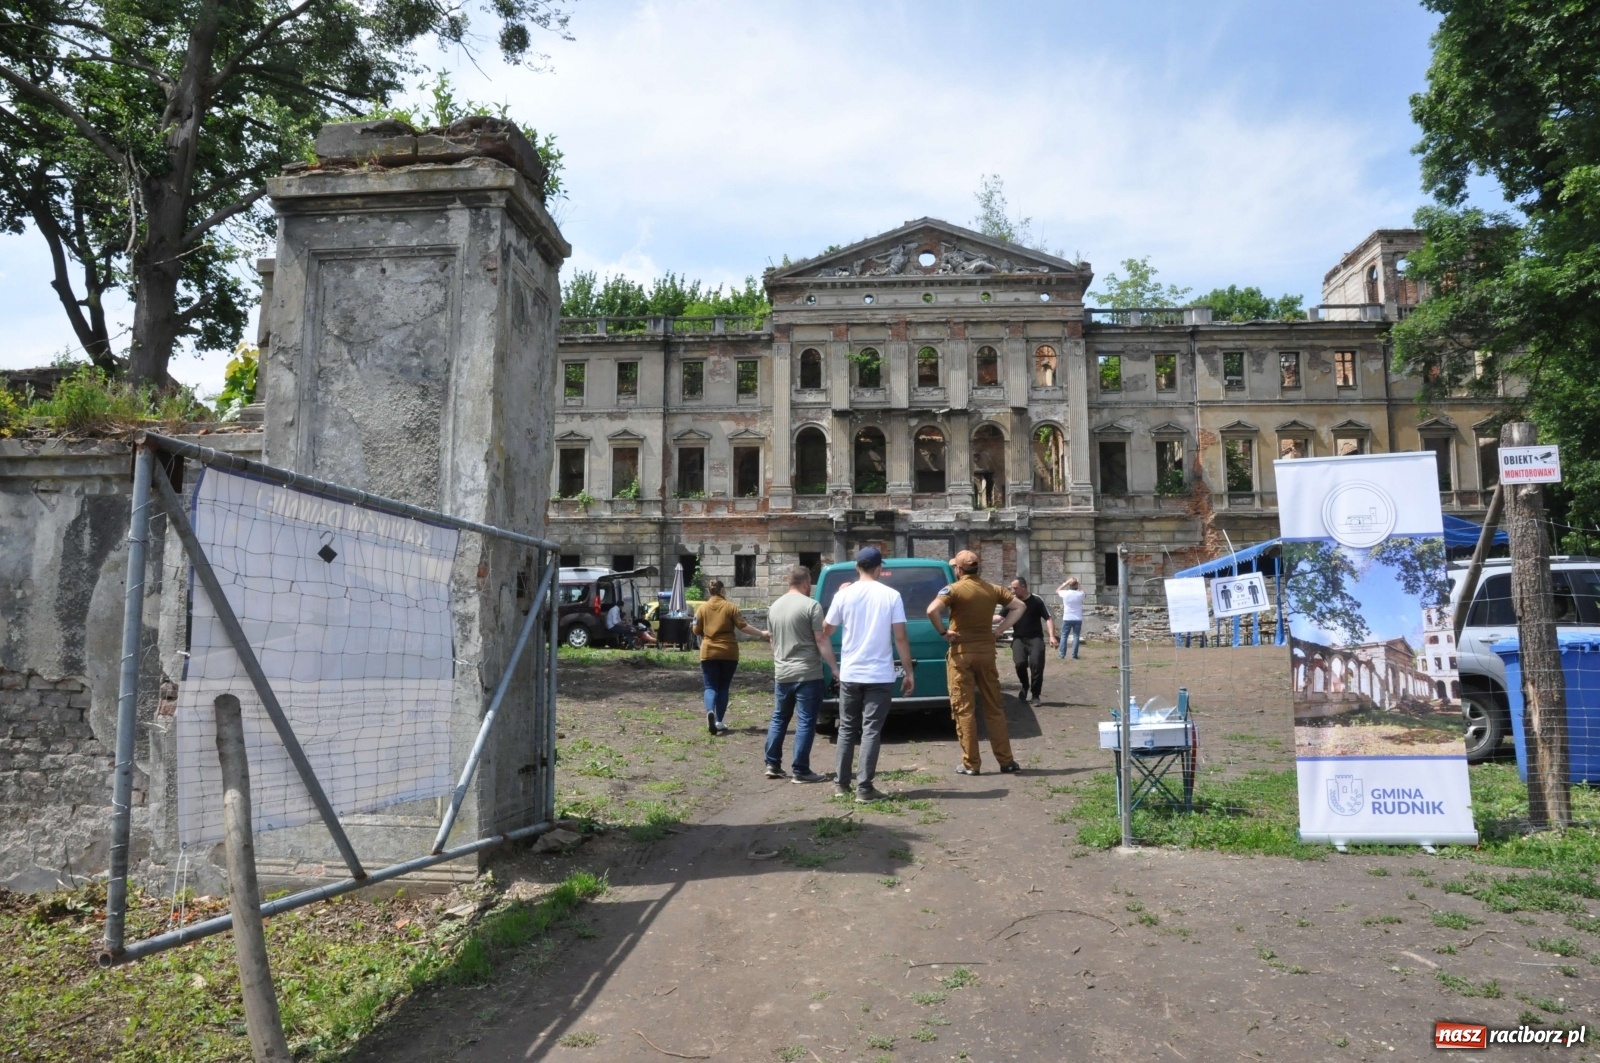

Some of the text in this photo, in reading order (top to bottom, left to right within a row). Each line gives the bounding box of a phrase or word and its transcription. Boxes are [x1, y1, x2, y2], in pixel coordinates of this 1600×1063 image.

[1503, 454, 1533, 465] OBIEKT
[1504, 467, 1556, 479] MONITOROWANY
[1371, 788, 1424, 800] GMINA
[1372, 801, 1445, 815] RUDNIK
